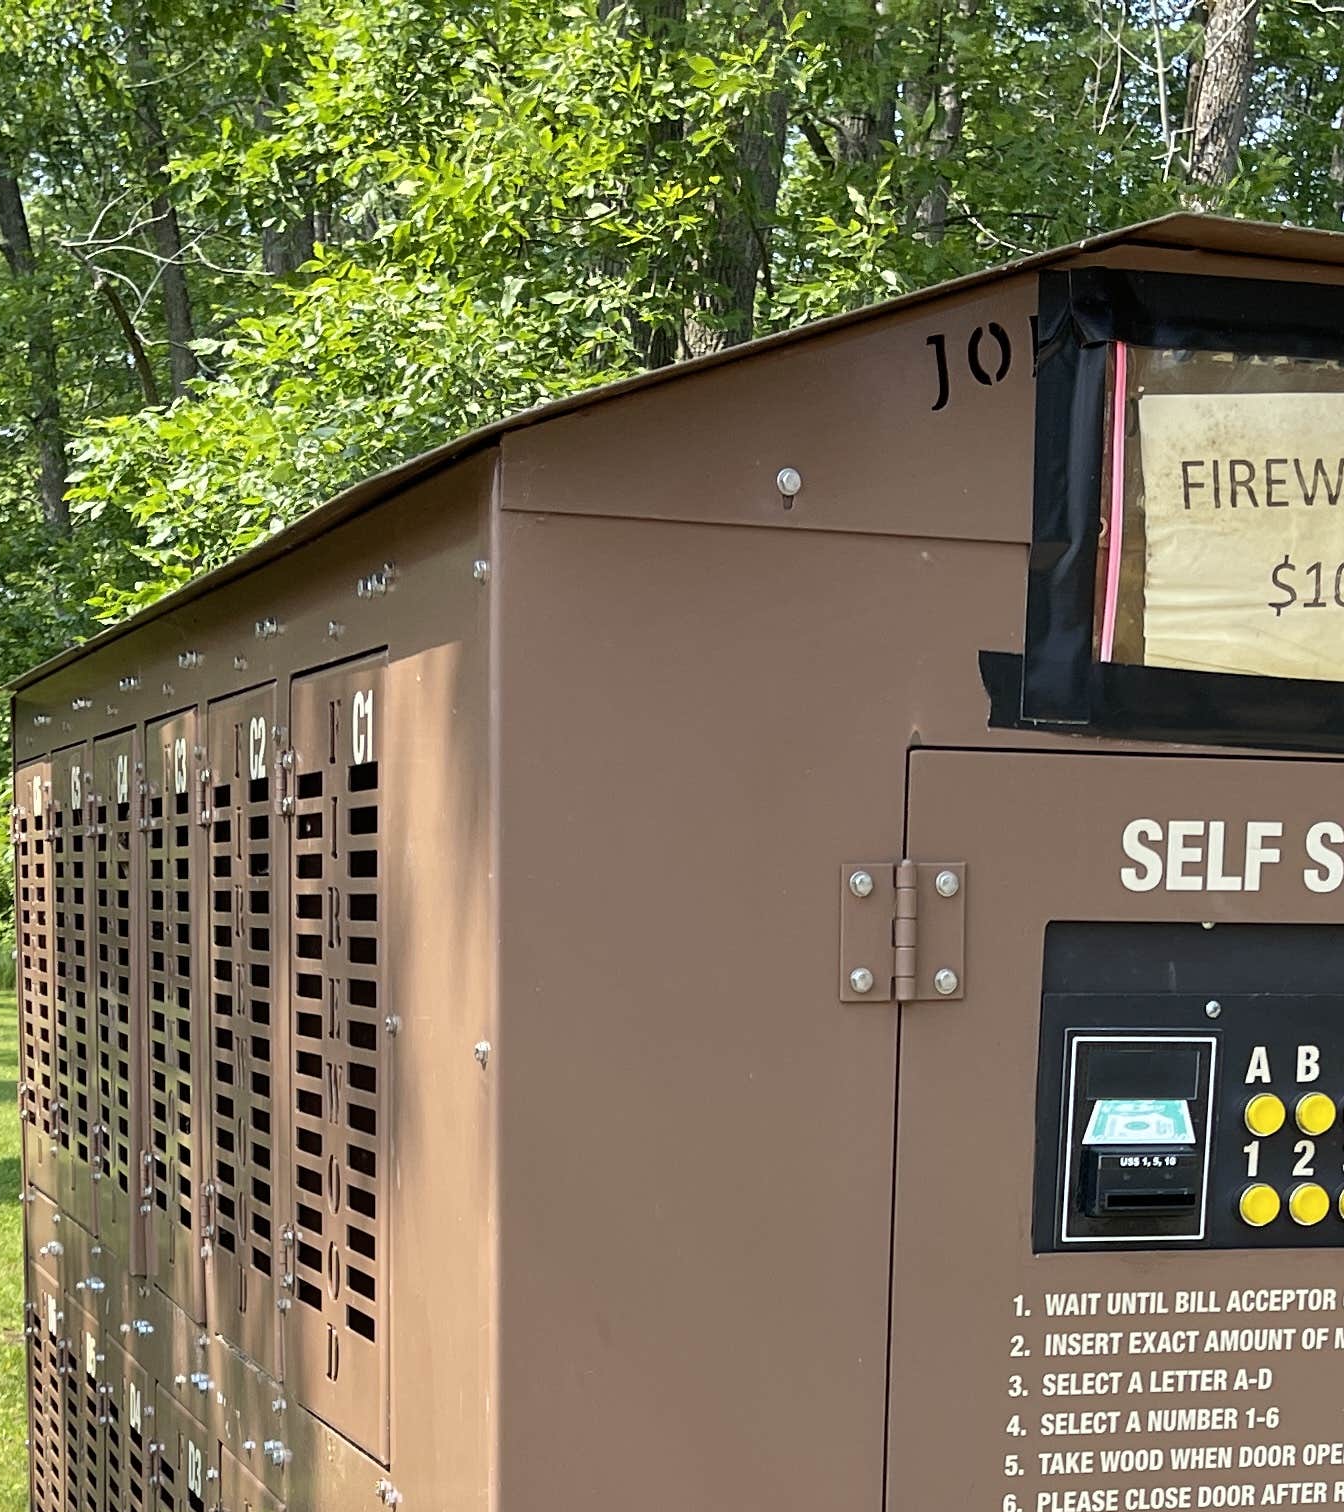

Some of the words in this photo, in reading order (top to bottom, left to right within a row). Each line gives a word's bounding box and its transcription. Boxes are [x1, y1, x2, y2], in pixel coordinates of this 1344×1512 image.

[249, 717, 266, 780] C2
[352, 689, 374, 766] C1
[117, 755, 128, 804] C4
[174, 738, 187, 794] C3
[1121, 819, 1282, 891] SELF
[325, 699, 343, 1383] FIREWOOD
[1245, 1047, 1270, 1083] A
[1297, 1046, 1319, 1082] B
[1244, 1141, 1259, 1176] 1
[1293, 1140, 1314, 1176] 2
[1014, 1295, 1030, 1316] 1.
[1046, 1293, 1101, 1315] WAIT
[1108, 1292, 1168, 1314] UNTIL
[1175, 1291, 1220, 1312] BILL
[1227, 1289, 1336, 1312] ACCEPTOR
[1011, 1336, 1030, 1356] 2.
[1045, 1333, 1123, 1355] INSERT
[1129, 1331, 1199, 1353] EXACT
[1204, 1329, 1296, 1351] AMOUNT
[1302, 1328, 1329, 1349] OF
[1009, 1376, 1028, 1396] 3.
[1043, 1372, 1122, 1395] SELECT
[1128, 1372, 1143, 1393] A
[1150, 1370, 1227, 1392] LETTER
[1233, 1368, 1272, 1390] A-D
[129, 1382, 142, 1434] D4
[1007, 1415, 1026, 1436] 4.
[1041, 1412, 1120, 1435] SELECT
[1126, 1411, 1141, 1432] A
[1148, 1408, 1237, 1431] NUMBER
[1246, 1408, 1279, 1428] 1-6
[188, 1439, 202, 1500] D3
[1005, 1455, 1024, 1475] 5.
[1039, 1452, 1093, 1474] TAKE
[1100, 1450, 1163, 1472] WOOD
[1171, 1447, 1232, 1469] WHEN
[1239, 1445, 1295, 1467] DOOR
[1037, 1490, 1118, 1512] PLEASE
[1126, 1487, 1191, 1510] CLOSE
[1198, 1485, 1255, 1507] DOOR
[1261, 1482, 1327, 1505] AFTER
